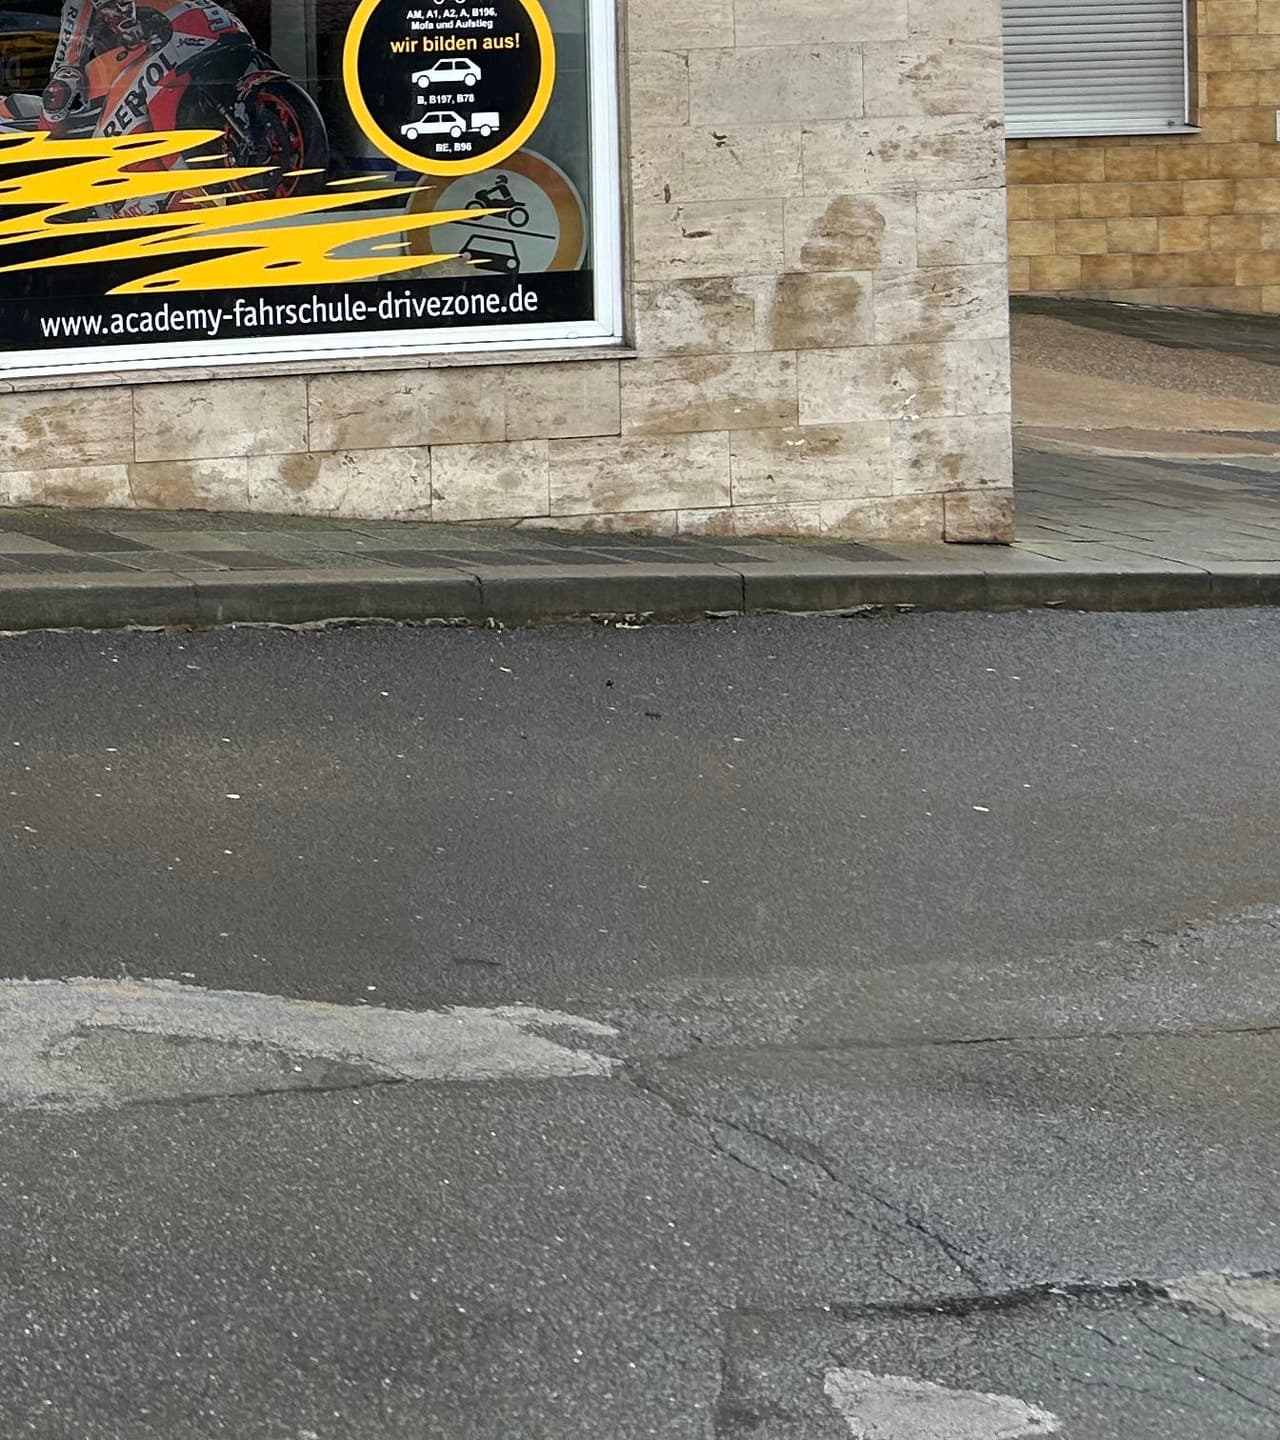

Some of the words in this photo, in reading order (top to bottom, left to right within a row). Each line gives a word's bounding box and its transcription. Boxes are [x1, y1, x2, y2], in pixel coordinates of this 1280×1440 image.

[406, 10, 425, 20] AM,
[426, 9, 441, 19] A1,
[443, 9, 458, 19] A2,
[459, 8, 470, 18] A,
[411, 20, 434, 30] Mofa
[436, 19, 454, 29] und
[455, 18, 494, 29] Aufstieg
[390, 36, 419, 53] wir
[422, 34, 478, 52] bilden
[482, 32, 520, 49] aus!
[417, 95, 428, 105] B,
[429, 94, 455, 105] B197,
[435, 143, 452, 152] BE,
[41, 285, 539, 338] www.academy-fahrschule-drivezone.de
